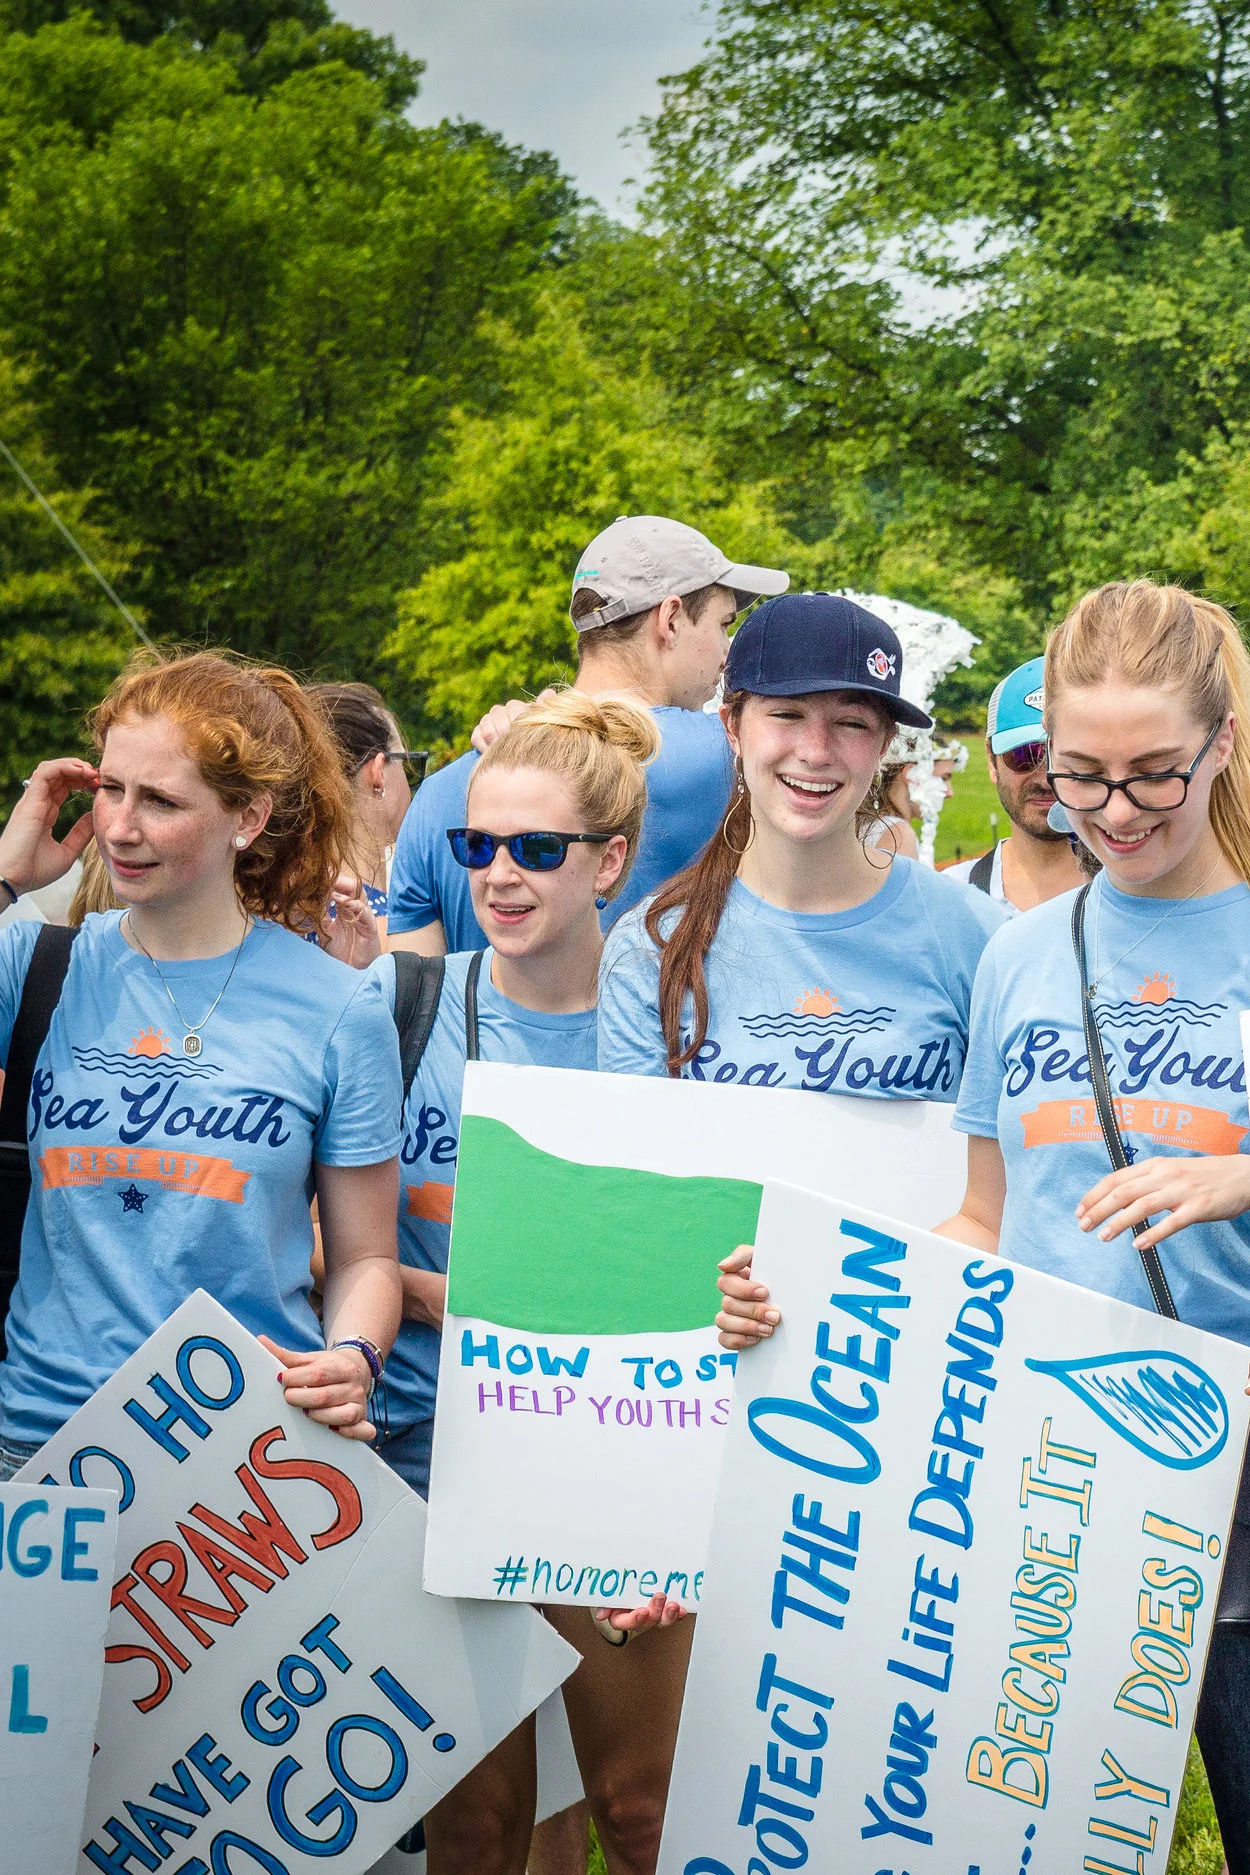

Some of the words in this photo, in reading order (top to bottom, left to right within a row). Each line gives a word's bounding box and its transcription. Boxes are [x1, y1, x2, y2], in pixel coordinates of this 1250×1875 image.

[1028, 695, 1044, 703] PAT
[28, 1067, 110, 1142] Sea
[118, 1080, 292, 1148] Youth
[794, 1036, 955, 1092] Youth
[68, 1152, 141, 1174] RISE
[159, 1157, 200, 1177] UP
[401, 1101, 458, 1168] Se
[1152, 1106, 1193, 1131] UP
[122, 1335, 246, 1463] HO
[461, 1329, 590, 1378] HOW
[621, 1356, 683, 1390] TO
[478, 1381, 576, 1416] HELP
[748, 1218, 911, 1484] OCEAN
[1019, 1416, 1098, 1528] IT
[0, 1499, 105, 1580] GE
[771, 1492, 862, 1630] THE
[860, 1700, 938, 1846] YOUR
[909, 1259, 1014, 1550] DEPENDS
[965, 1525, 1083, 1810] BECAUSE
[83, 1732, 251, 1875] HAVE
[240, 1613, 353, 1746] GOT
[266, 1666, 457, 1857] GO!
[682, 1653, 835, 1875] OTECT
